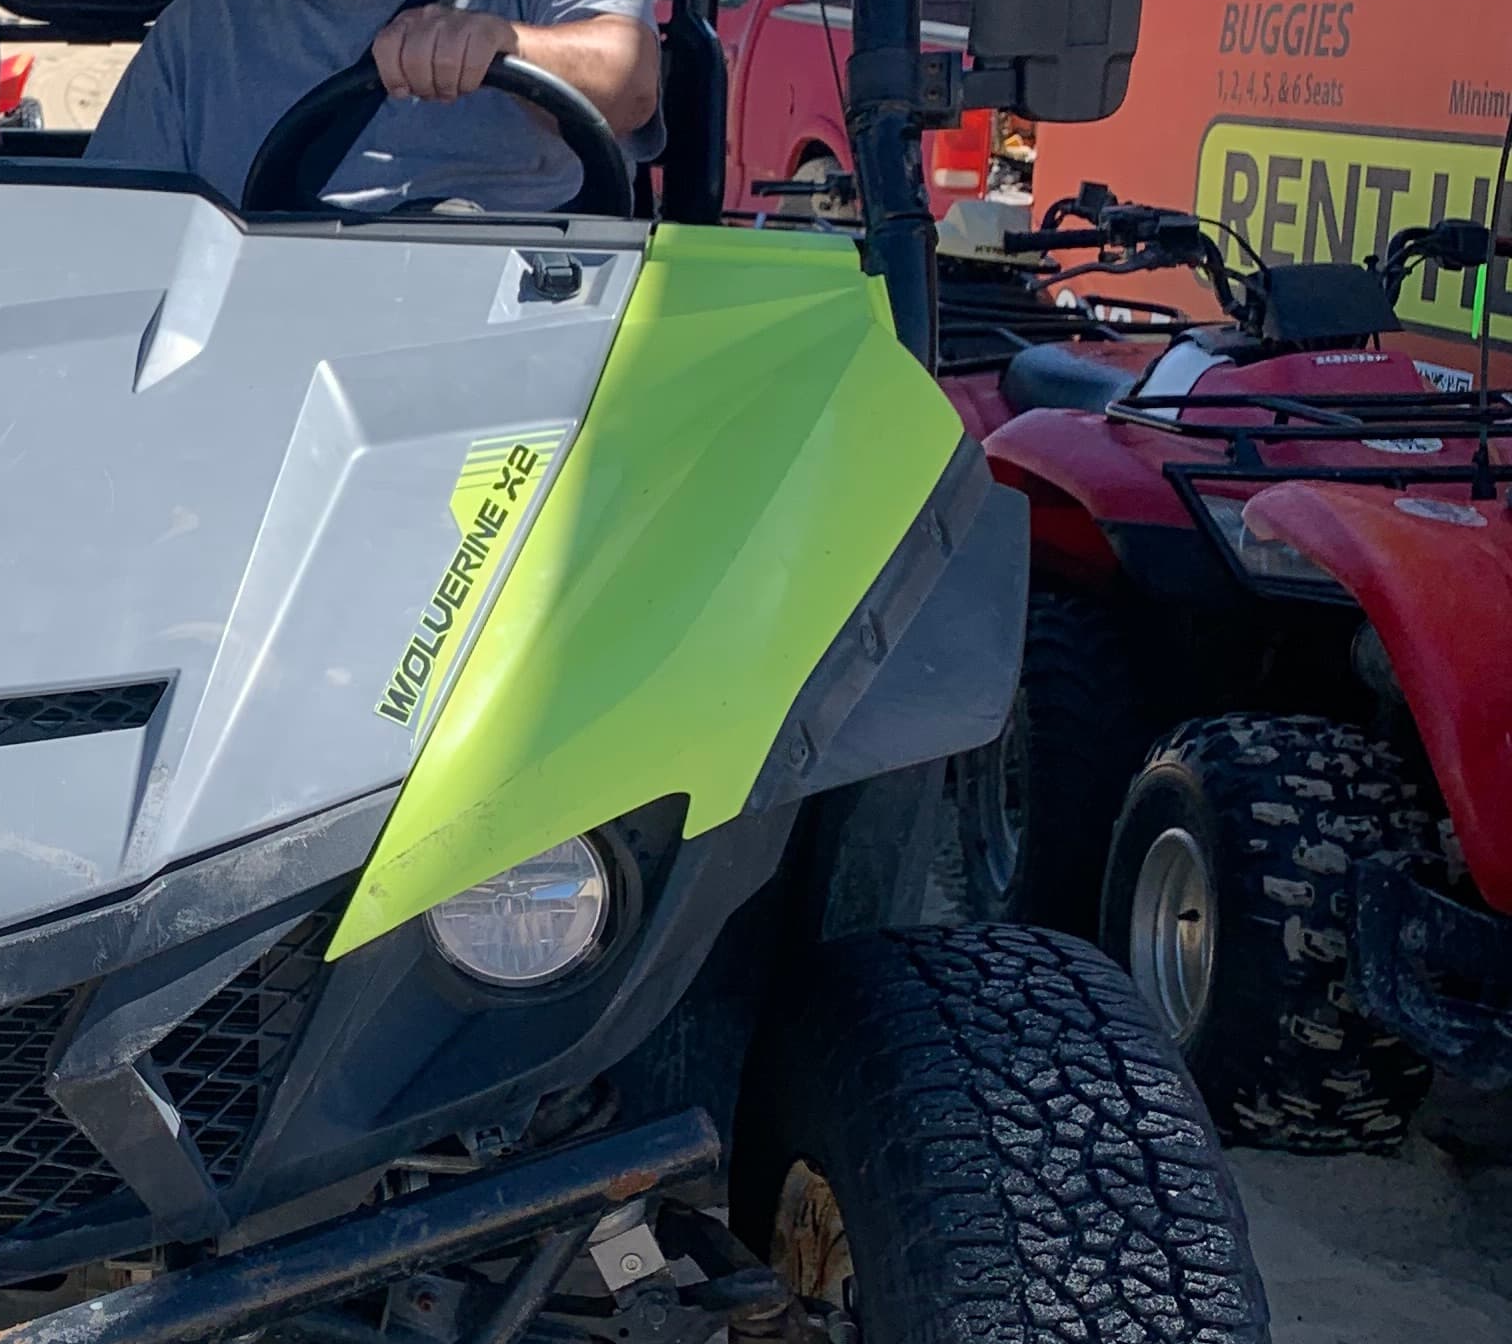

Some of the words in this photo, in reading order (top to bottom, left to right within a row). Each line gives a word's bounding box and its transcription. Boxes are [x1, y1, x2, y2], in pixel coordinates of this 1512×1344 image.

[1219, 2, 1355, 58] BUGGIES
[1278, 71, 1290, 102] &
[1292, 73, 1303, 104] 6
[1304, 72, 1345, 107] Seats
[1218, 150, 1412, 270] RENT
[379, 497, 509, 725] WOLVERINE
[492, 443, 539, 502] X2
